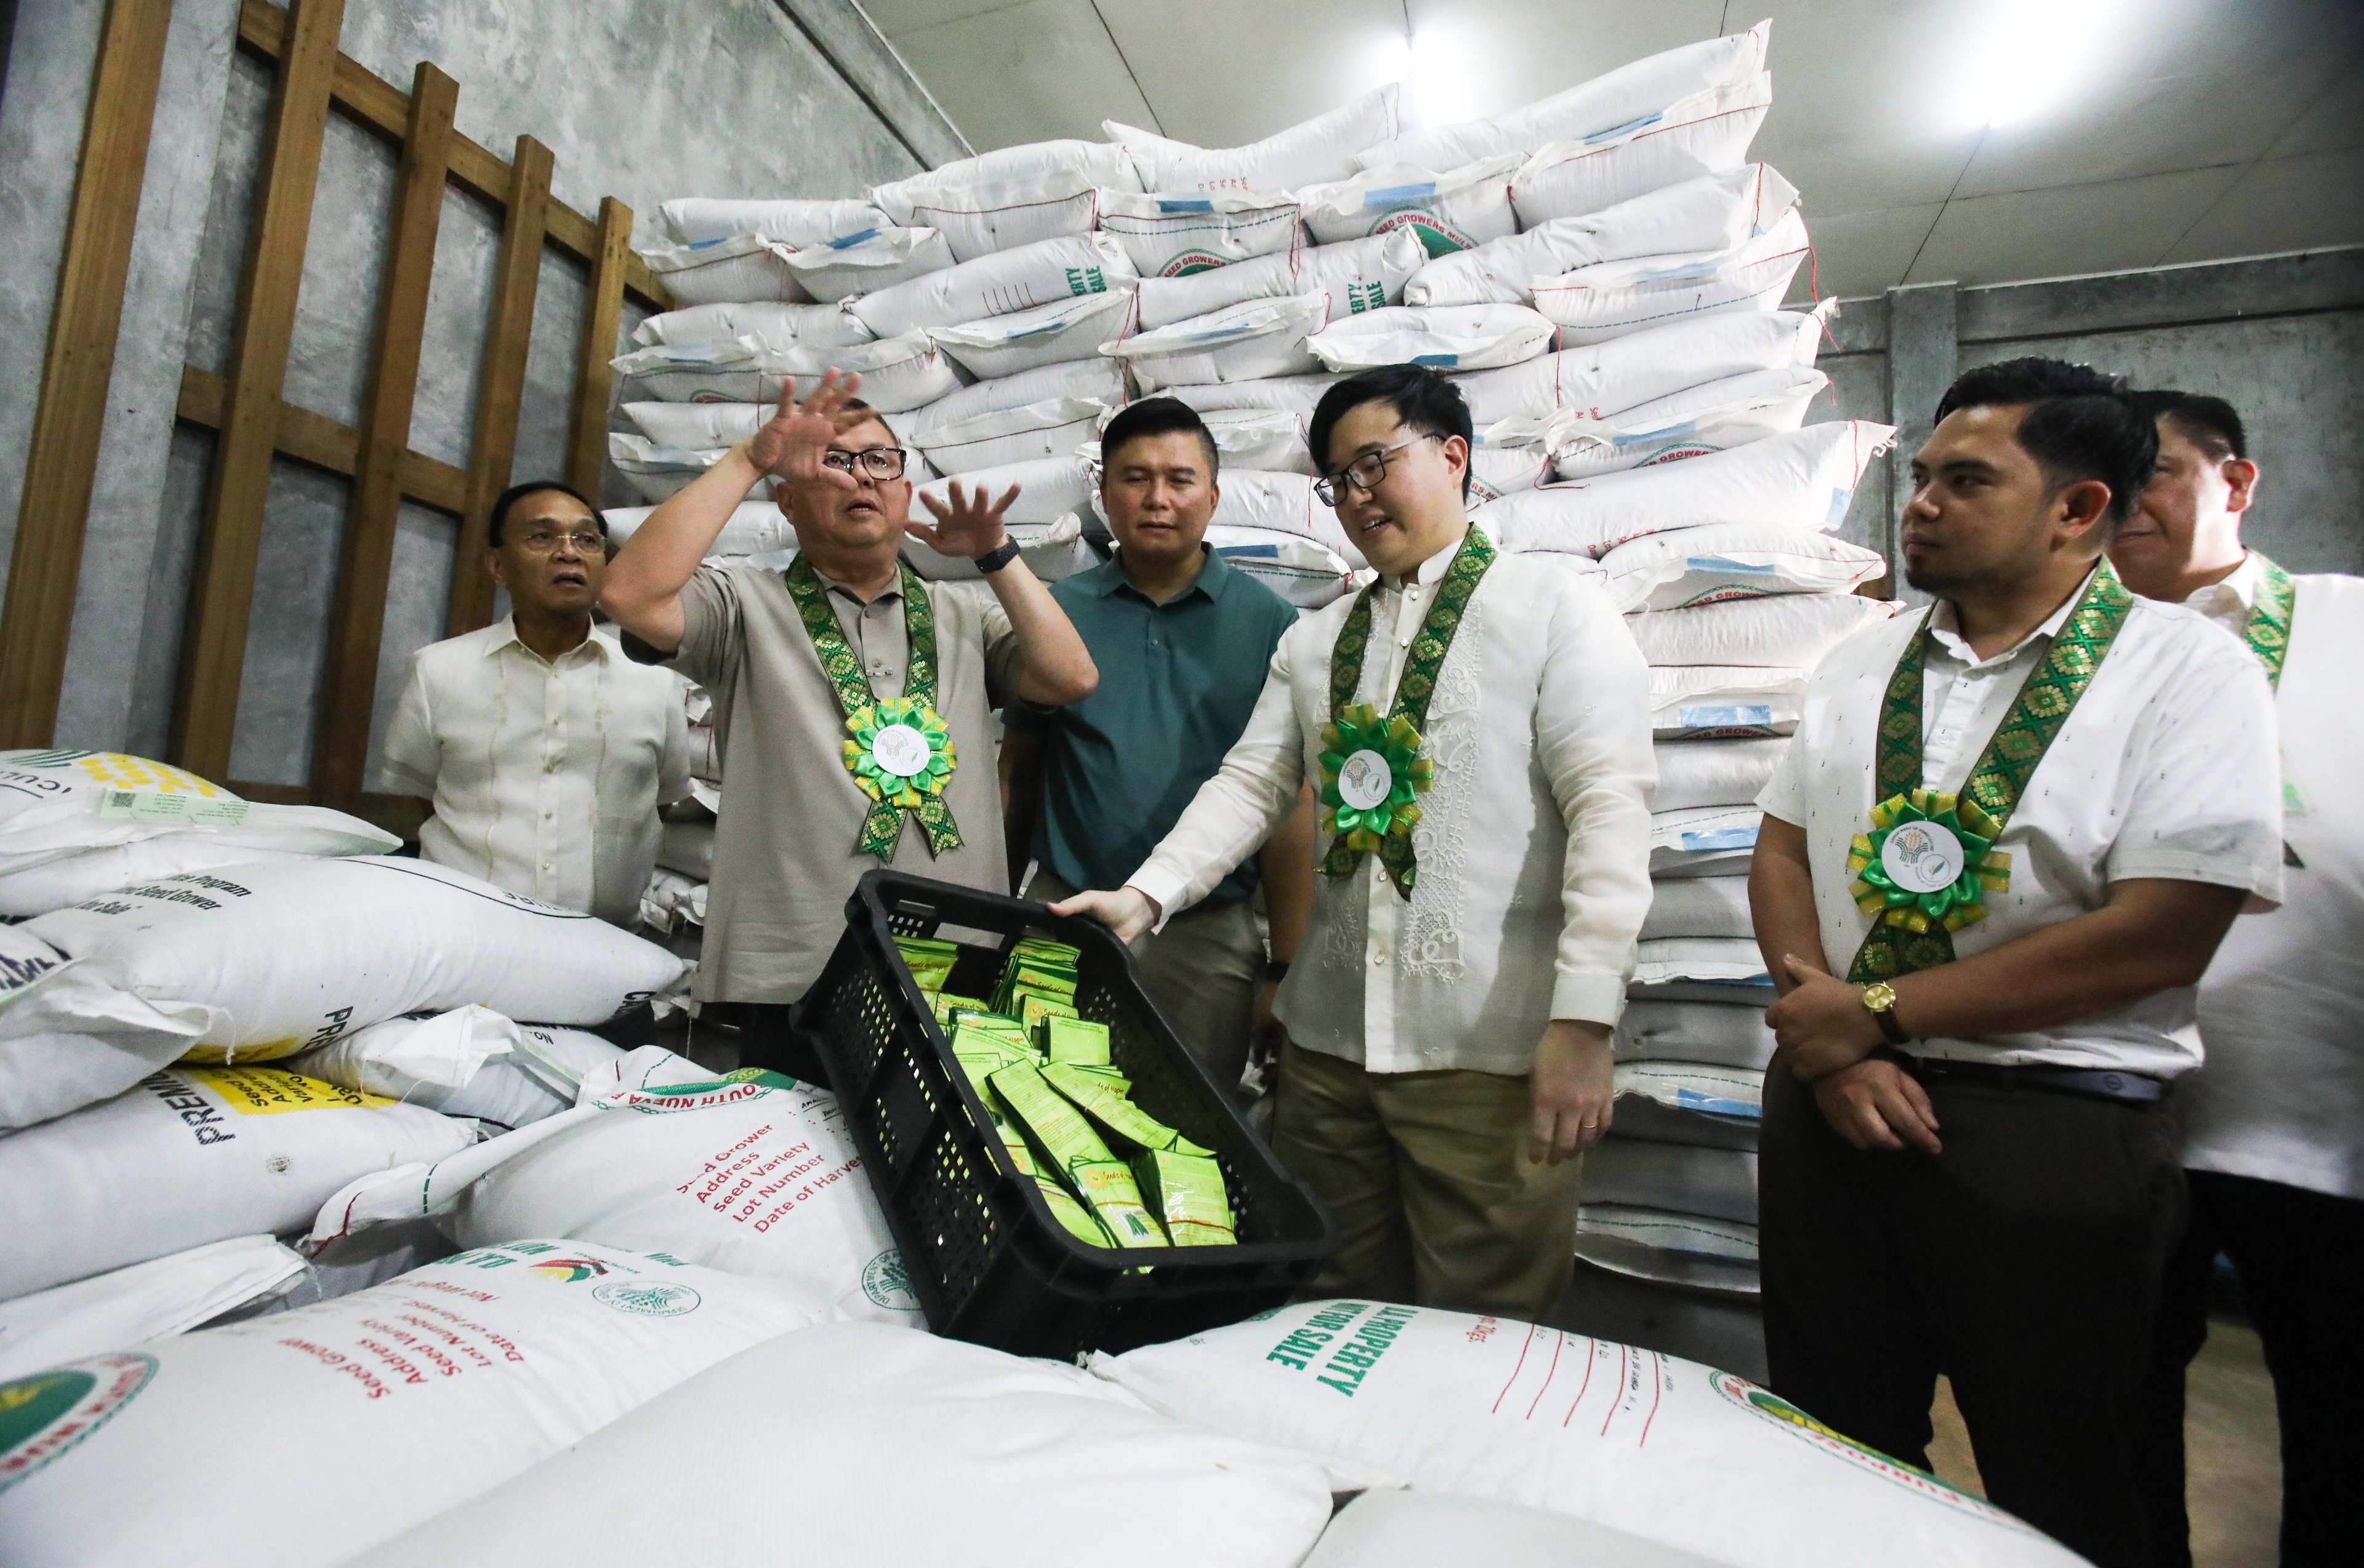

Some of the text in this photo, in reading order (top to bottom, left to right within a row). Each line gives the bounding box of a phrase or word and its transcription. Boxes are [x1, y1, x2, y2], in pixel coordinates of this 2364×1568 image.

[167, 890, 222, 910] Grower
[701, 1085, 765, 1106] OUTH
[715, 1124, 773, 1162] Grower
[696, 1152, 760, 1204] Address
[713, 1142, 811, 1213] Seed Variety
[733, 1154, 825, 1222] Lot Number
[754, 1201, 795, 1233] Date
[796, 1185, 814, 1202] of
[278, 1337, 392, 1399] Seed Grower
[356, 1338, 429, 1385] Address
[411, 1344, 462, 1377] Seed
[462, 1346, 493, 1367] Lot
[485, 1333, 525, 1362] Date
[1266, 1329, 1334, 1371] SALE
[1316, 1316, 1407, 1397] PROPERTY
